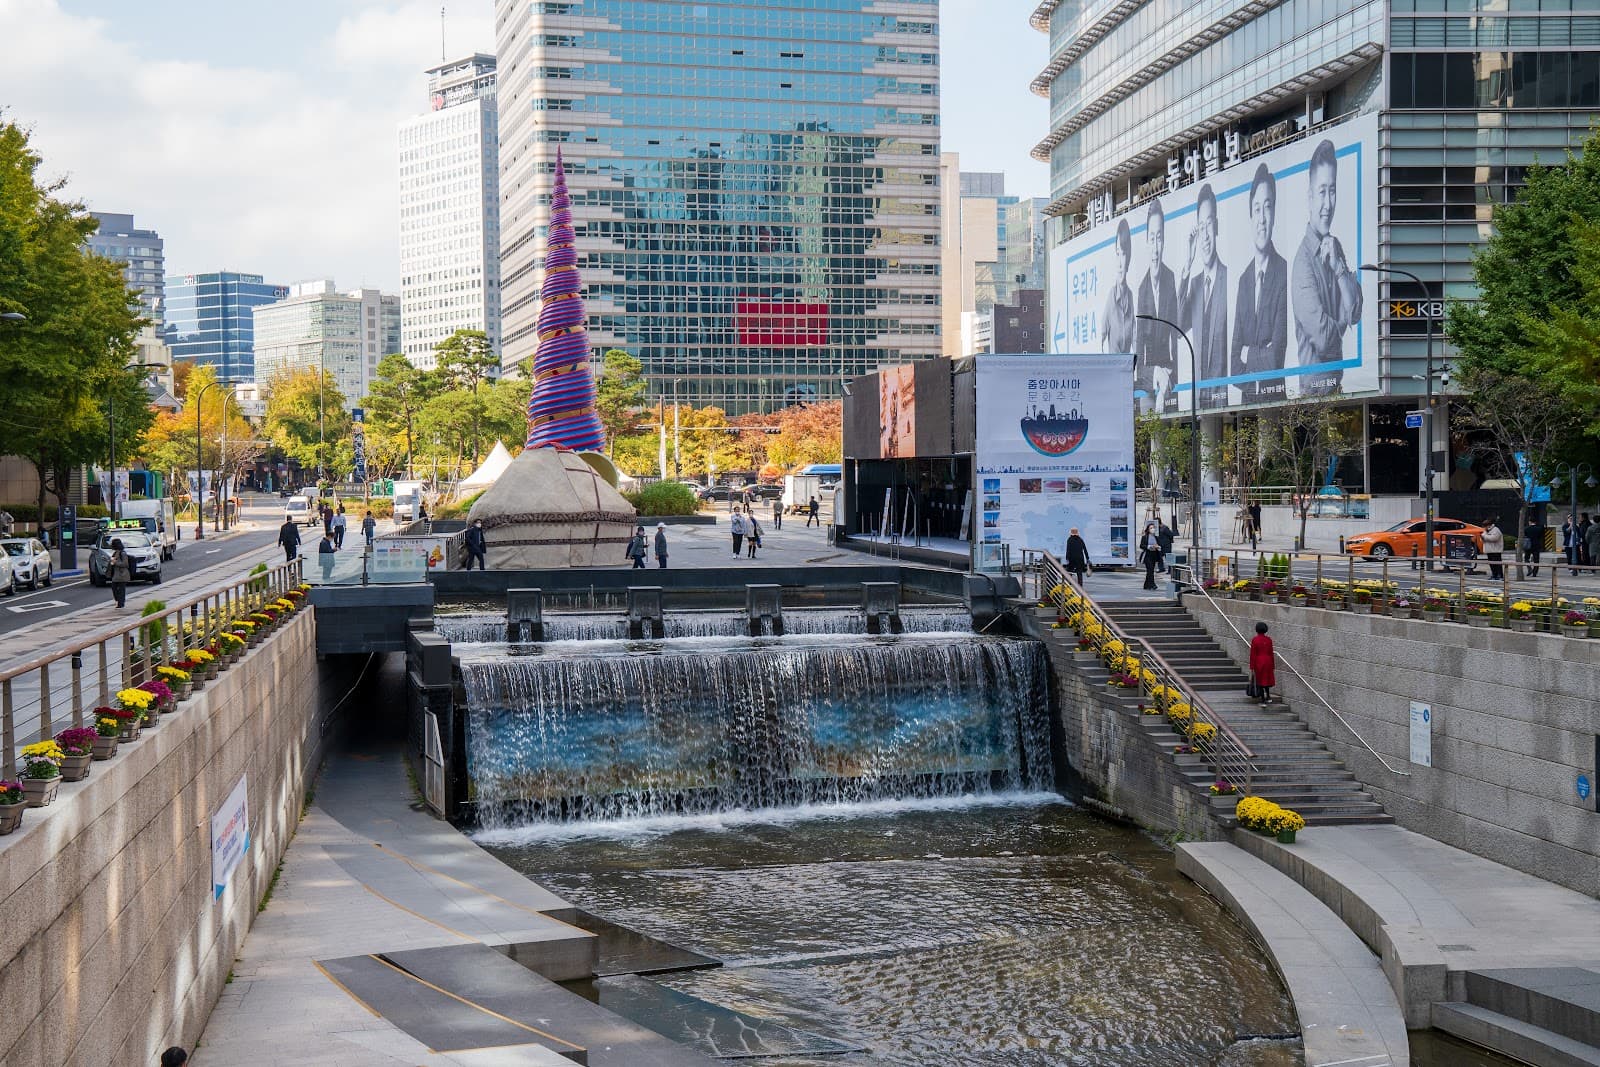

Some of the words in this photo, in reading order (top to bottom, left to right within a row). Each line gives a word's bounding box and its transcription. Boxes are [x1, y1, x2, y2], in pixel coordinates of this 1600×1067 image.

[1166, 131, 1242, 193] 동아일보
[1073, 265, 1098, 303] 우리가
[1417, 302, 1443, 317] KB
[1073, 312, 1097, 344] 채널A
[1027, 379, 1081, 390] 중앙아시아
